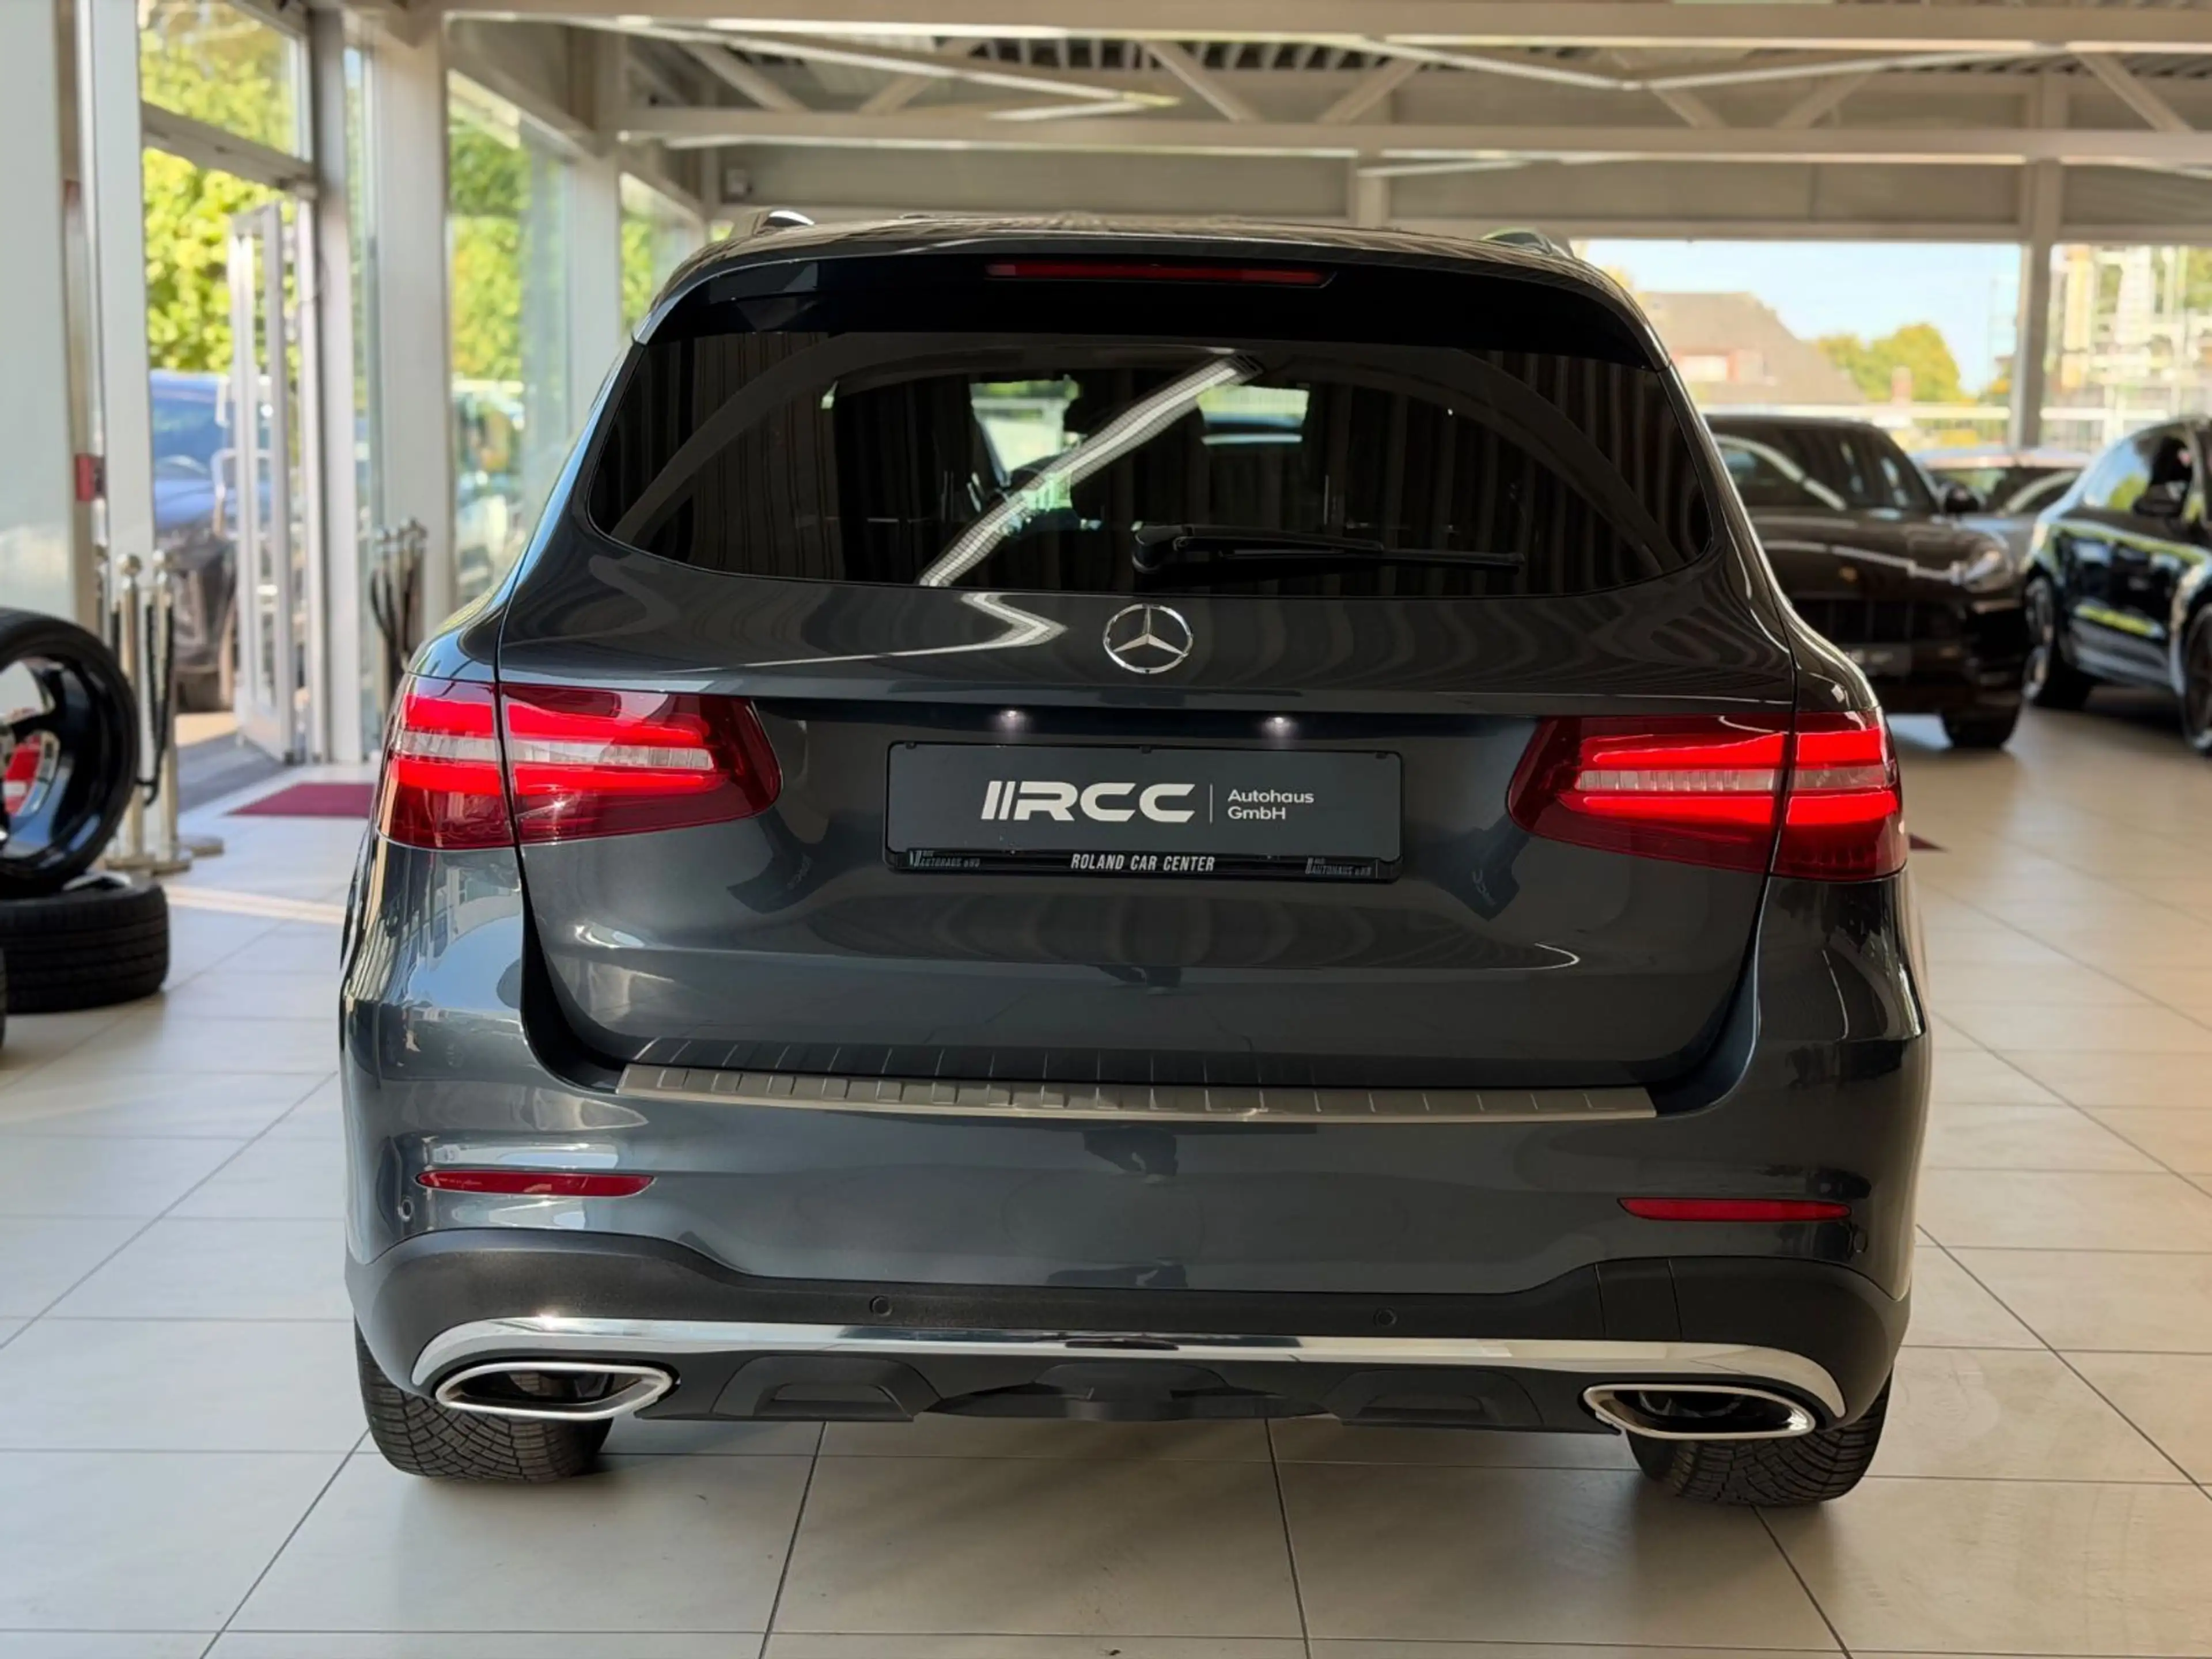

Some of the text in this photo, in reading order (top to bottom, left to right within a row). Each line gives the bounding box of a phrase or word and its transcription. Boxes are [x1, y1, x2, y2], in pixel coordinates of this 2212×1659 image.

[1228, 789, 1315, 803] Autohaus
[1228, 806, 1286, 820] GmbH
[1070, 854, 1215, 872] ROLAND CAR CENTER
